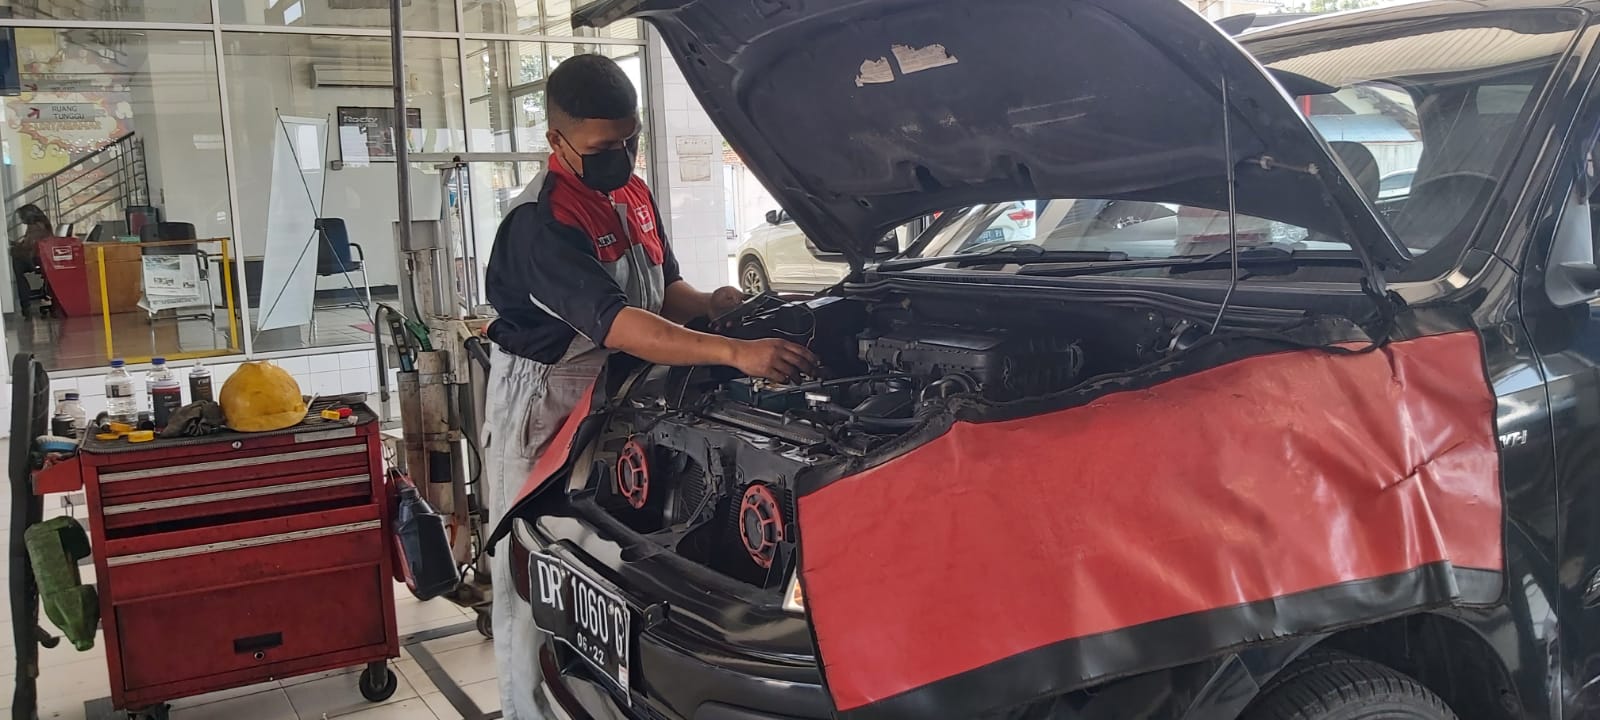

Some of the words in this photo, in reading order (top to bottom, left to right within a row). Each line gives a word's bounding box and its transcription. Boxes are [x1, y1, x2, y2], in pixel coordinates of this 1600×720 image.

[537, 560, 564, 610] DR
[571, 575, 608, 643] 1060
[614, 606, 625, 658] G
